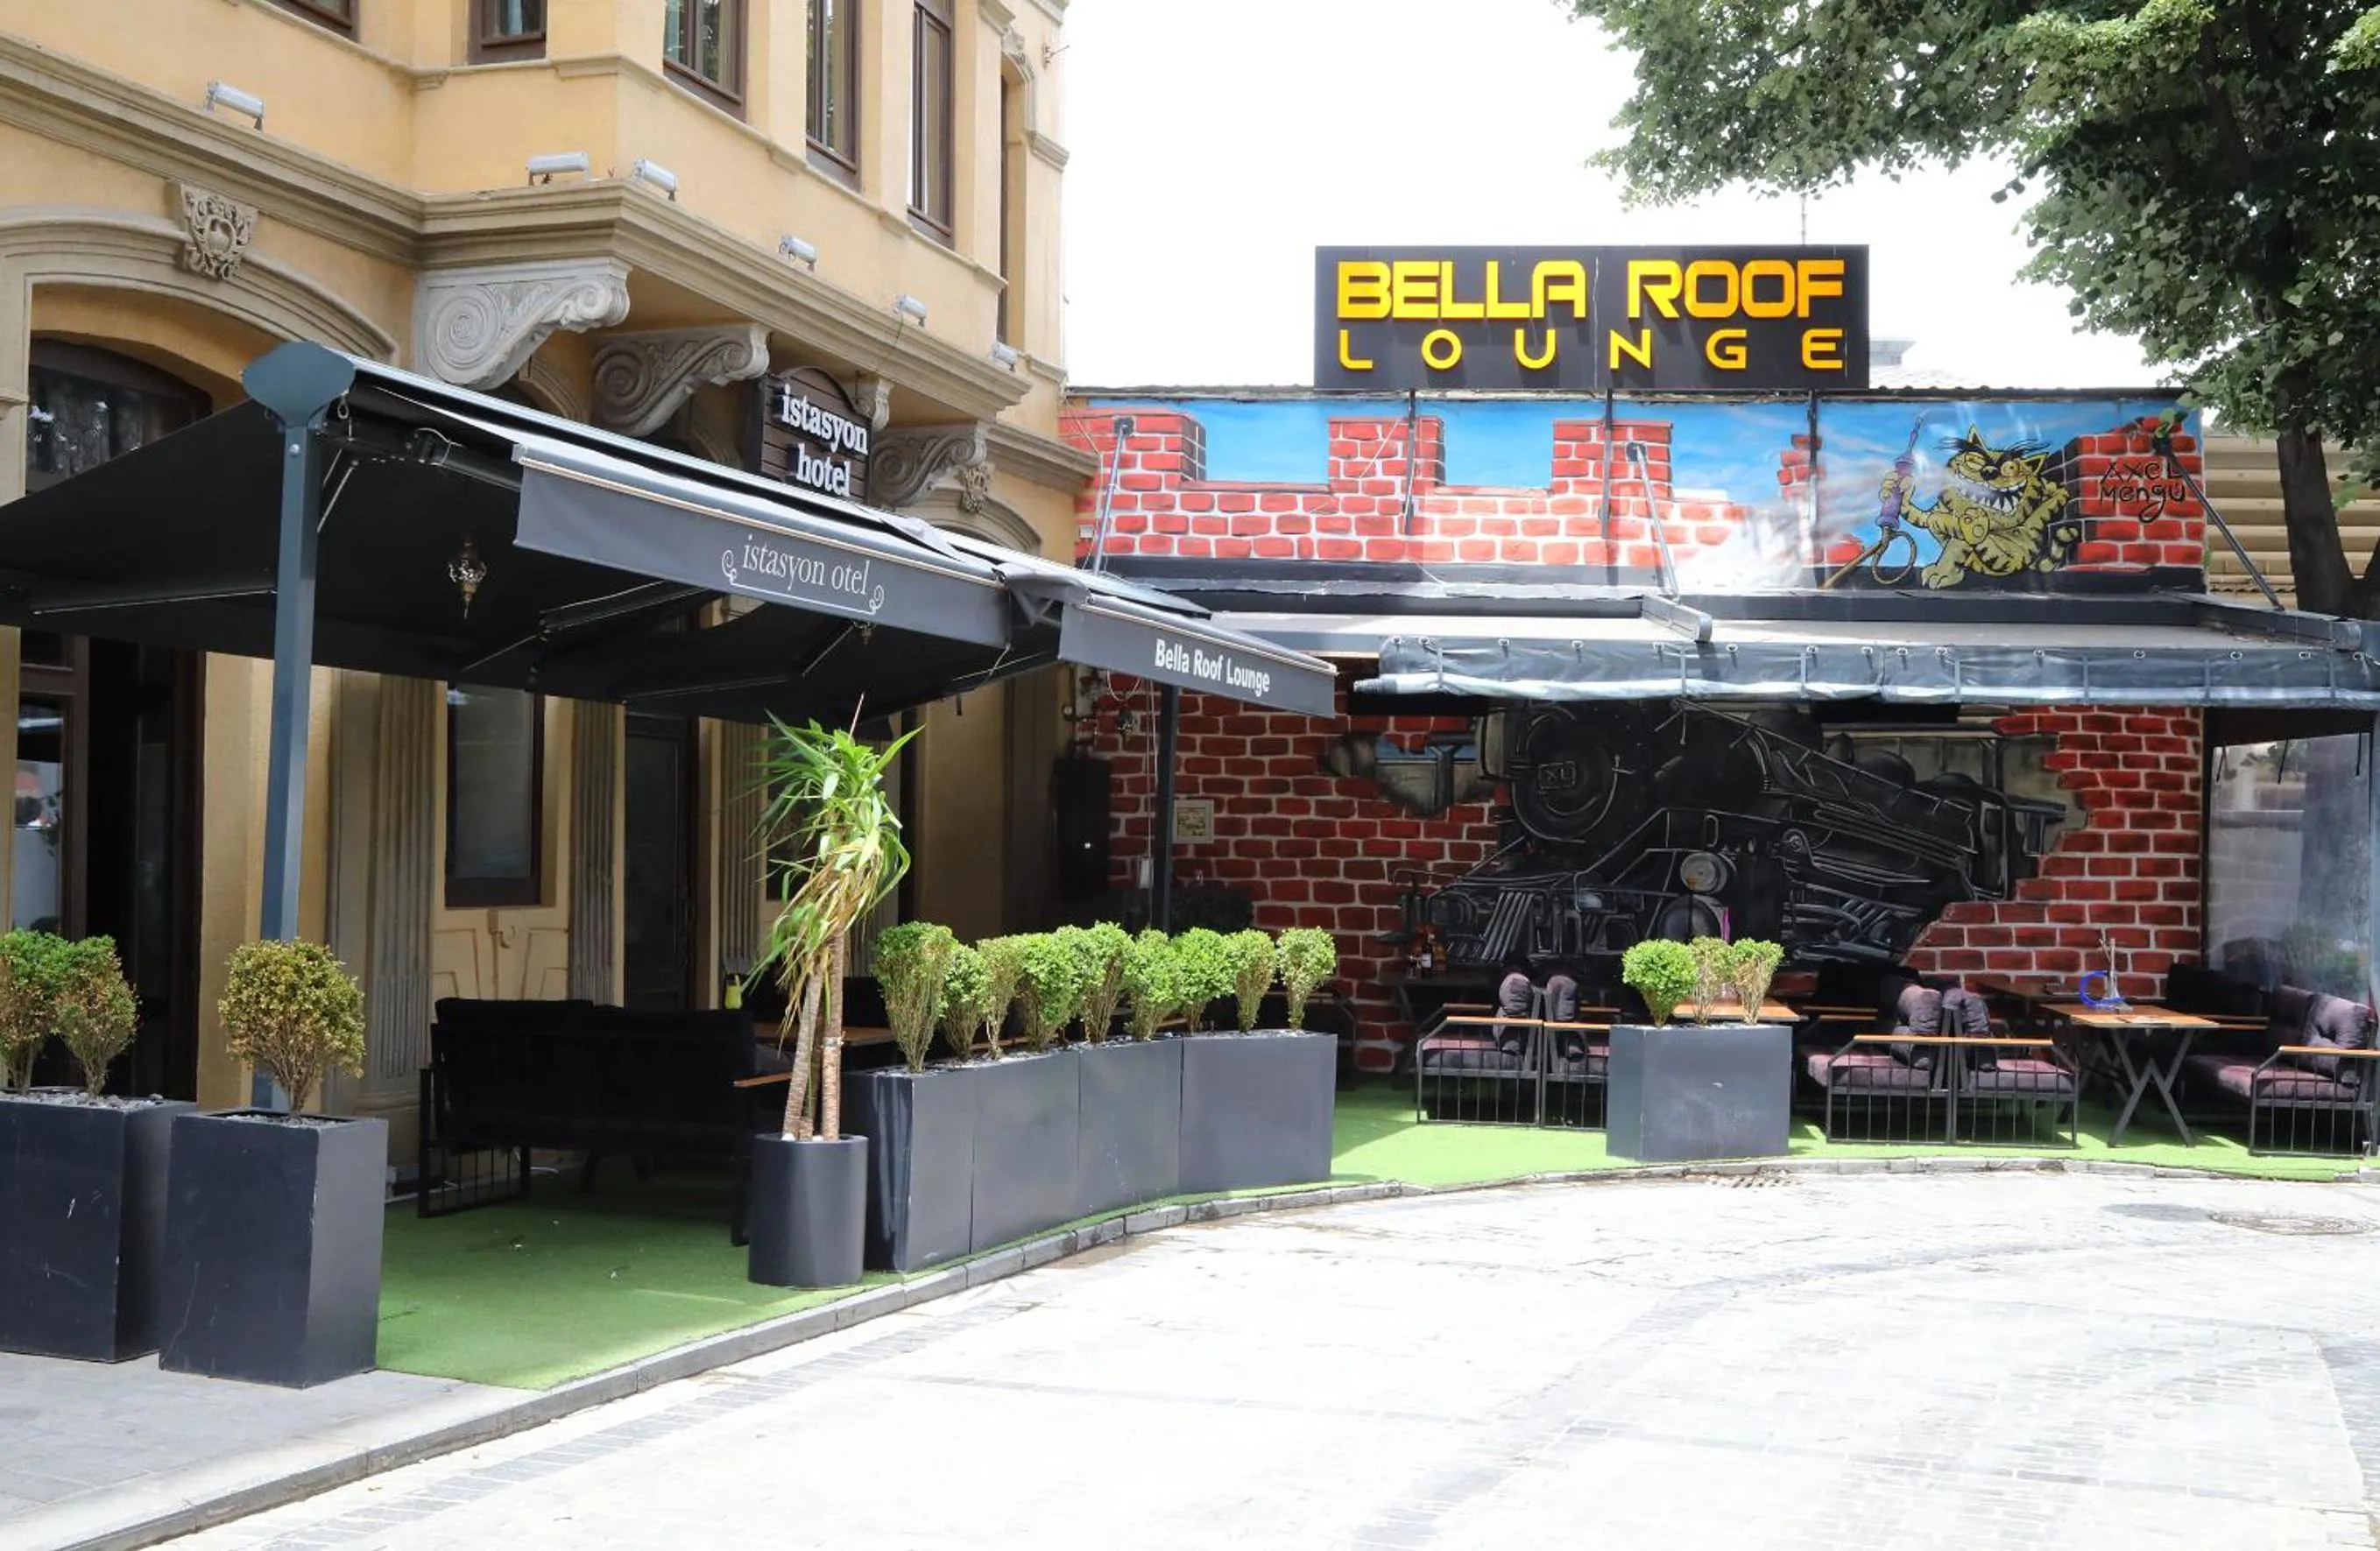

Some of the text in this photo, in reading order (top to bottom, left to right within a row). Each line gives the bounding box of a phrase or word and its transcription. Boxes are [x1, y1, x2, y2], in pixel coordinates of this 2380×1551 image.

[1337, 259, 1845, 318] BELLA ROOF
[1337, 328, 1844, 369] LOUNGE
[780, 384, 869, 455] istasyon
[795, 443, 851, 497] hotel
[741, 533, 871, 596] istasyon otel
[1154, 638, 1271, 697] Bella Roof Lounge
